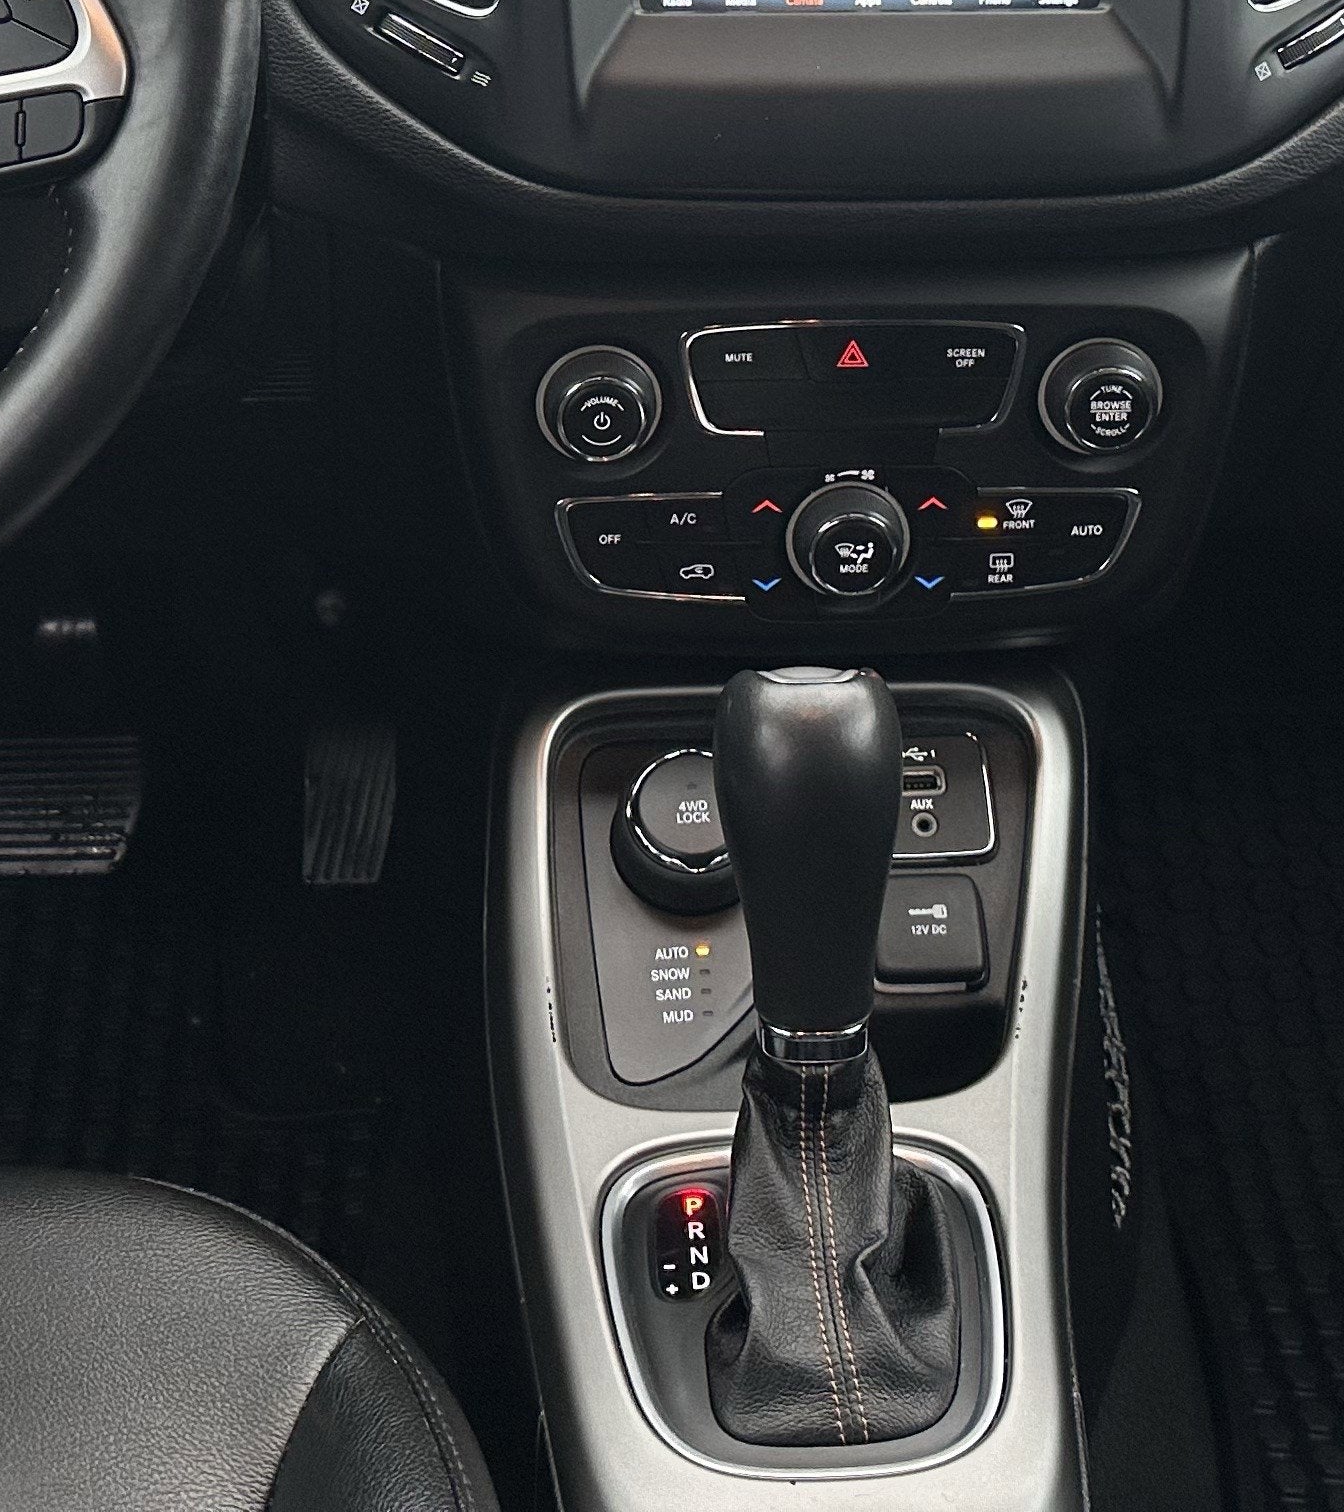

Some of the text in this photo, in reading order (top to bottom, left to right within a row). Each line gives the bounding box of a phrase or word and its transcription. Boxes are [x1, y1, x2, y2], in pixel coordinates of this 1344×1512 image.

[725, 353, 752, 362] MUTE
[947, 349, 985, 357] SCREEN
[956, 359, 974, 367] OFF
[1100, 385, 1123, 395] TUNE
[586, 396, 619, 408] VOLUME
[1089, 401, 1132, 410] BROWSE
[1093, 412, 1128, 422] ENTER
[1094, 425, 1125, 437] SCROLL
[670, 513, 696, 525] A/C
[1003, 520, 1034, 529] FRONT
[1071, 525, 1102, 535] AUTO
[599, 535, 621, 544] OFF
[840, 563, 868, 573] MODE
[988, 574, 1012, 583] REAR
[679, 800, 709, 813] 4WD
[911, 799, 933, 809] AUX
[677, 812, 710, 823] LOCK
[912, 924, 946, 935] 12V DC
[655, 946, 688, 960] AUTO
[651, 967, 689, 981] SNOW
[656, 988, 691, 1000] SAND
[663, 1010, 693, 1023] MUD
[685, 1196, 703, 1215] P
[688, 1220, 705, 1239] R
[690, 1246, 708, 1264] N
[692, 1272, 710, 1289] D
